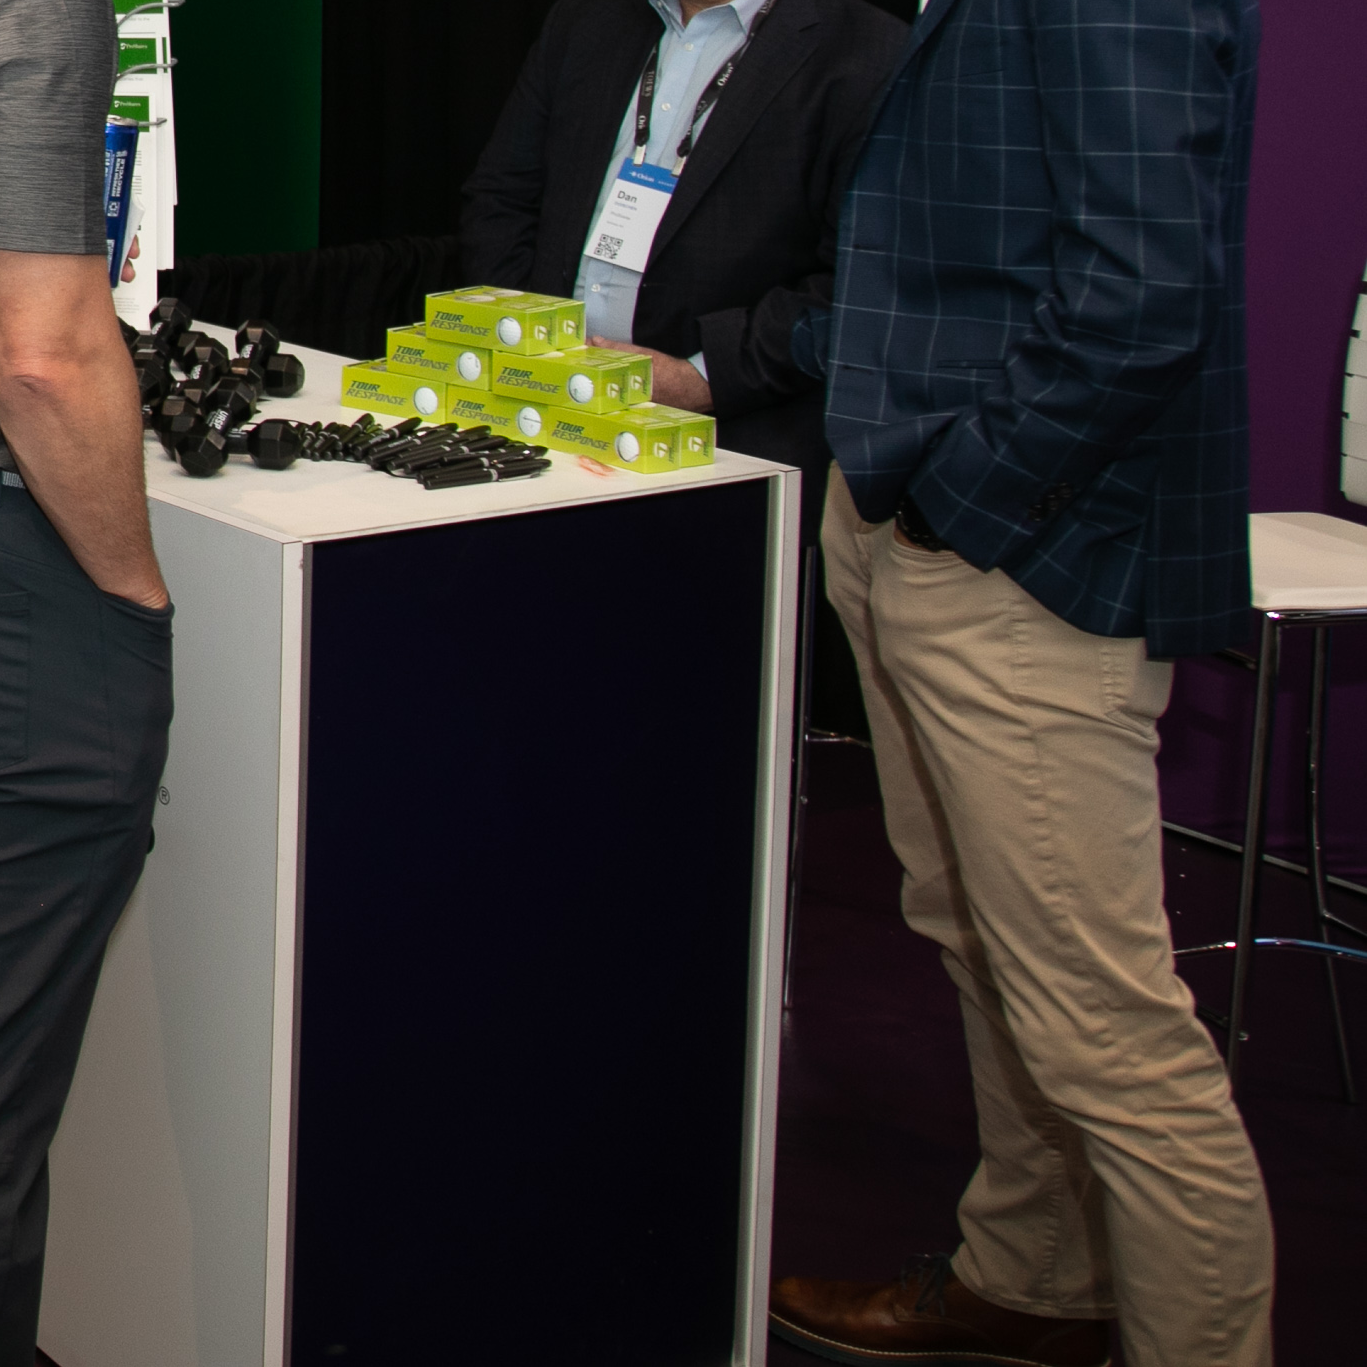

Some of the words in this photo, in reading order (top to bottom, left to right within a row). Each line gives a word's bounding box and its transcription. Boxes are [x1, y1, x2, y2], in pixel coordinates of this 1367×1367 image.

[617, 190, 637, 204] Dan
[434, 311, 464, 323] TOUR
[430, 319, 490, 337] RESPONSE
[396, 345, 425, 357] TOUR
[391, 354, 451, 372] RESPONSE
[502, 367, 533, 379] TOUR
[351, 380, 380, 393] TOUR
[497, 375, 560, 394] RESPONSE
[346, 389, 407, 406] RESPONSE
[456, 399, 485, 412] TOUR
[451, 407, 511, 427] RESPONSE
[555, 420, 584, 434] TOUR
[551, 429, 611, 451] RESPONSE
